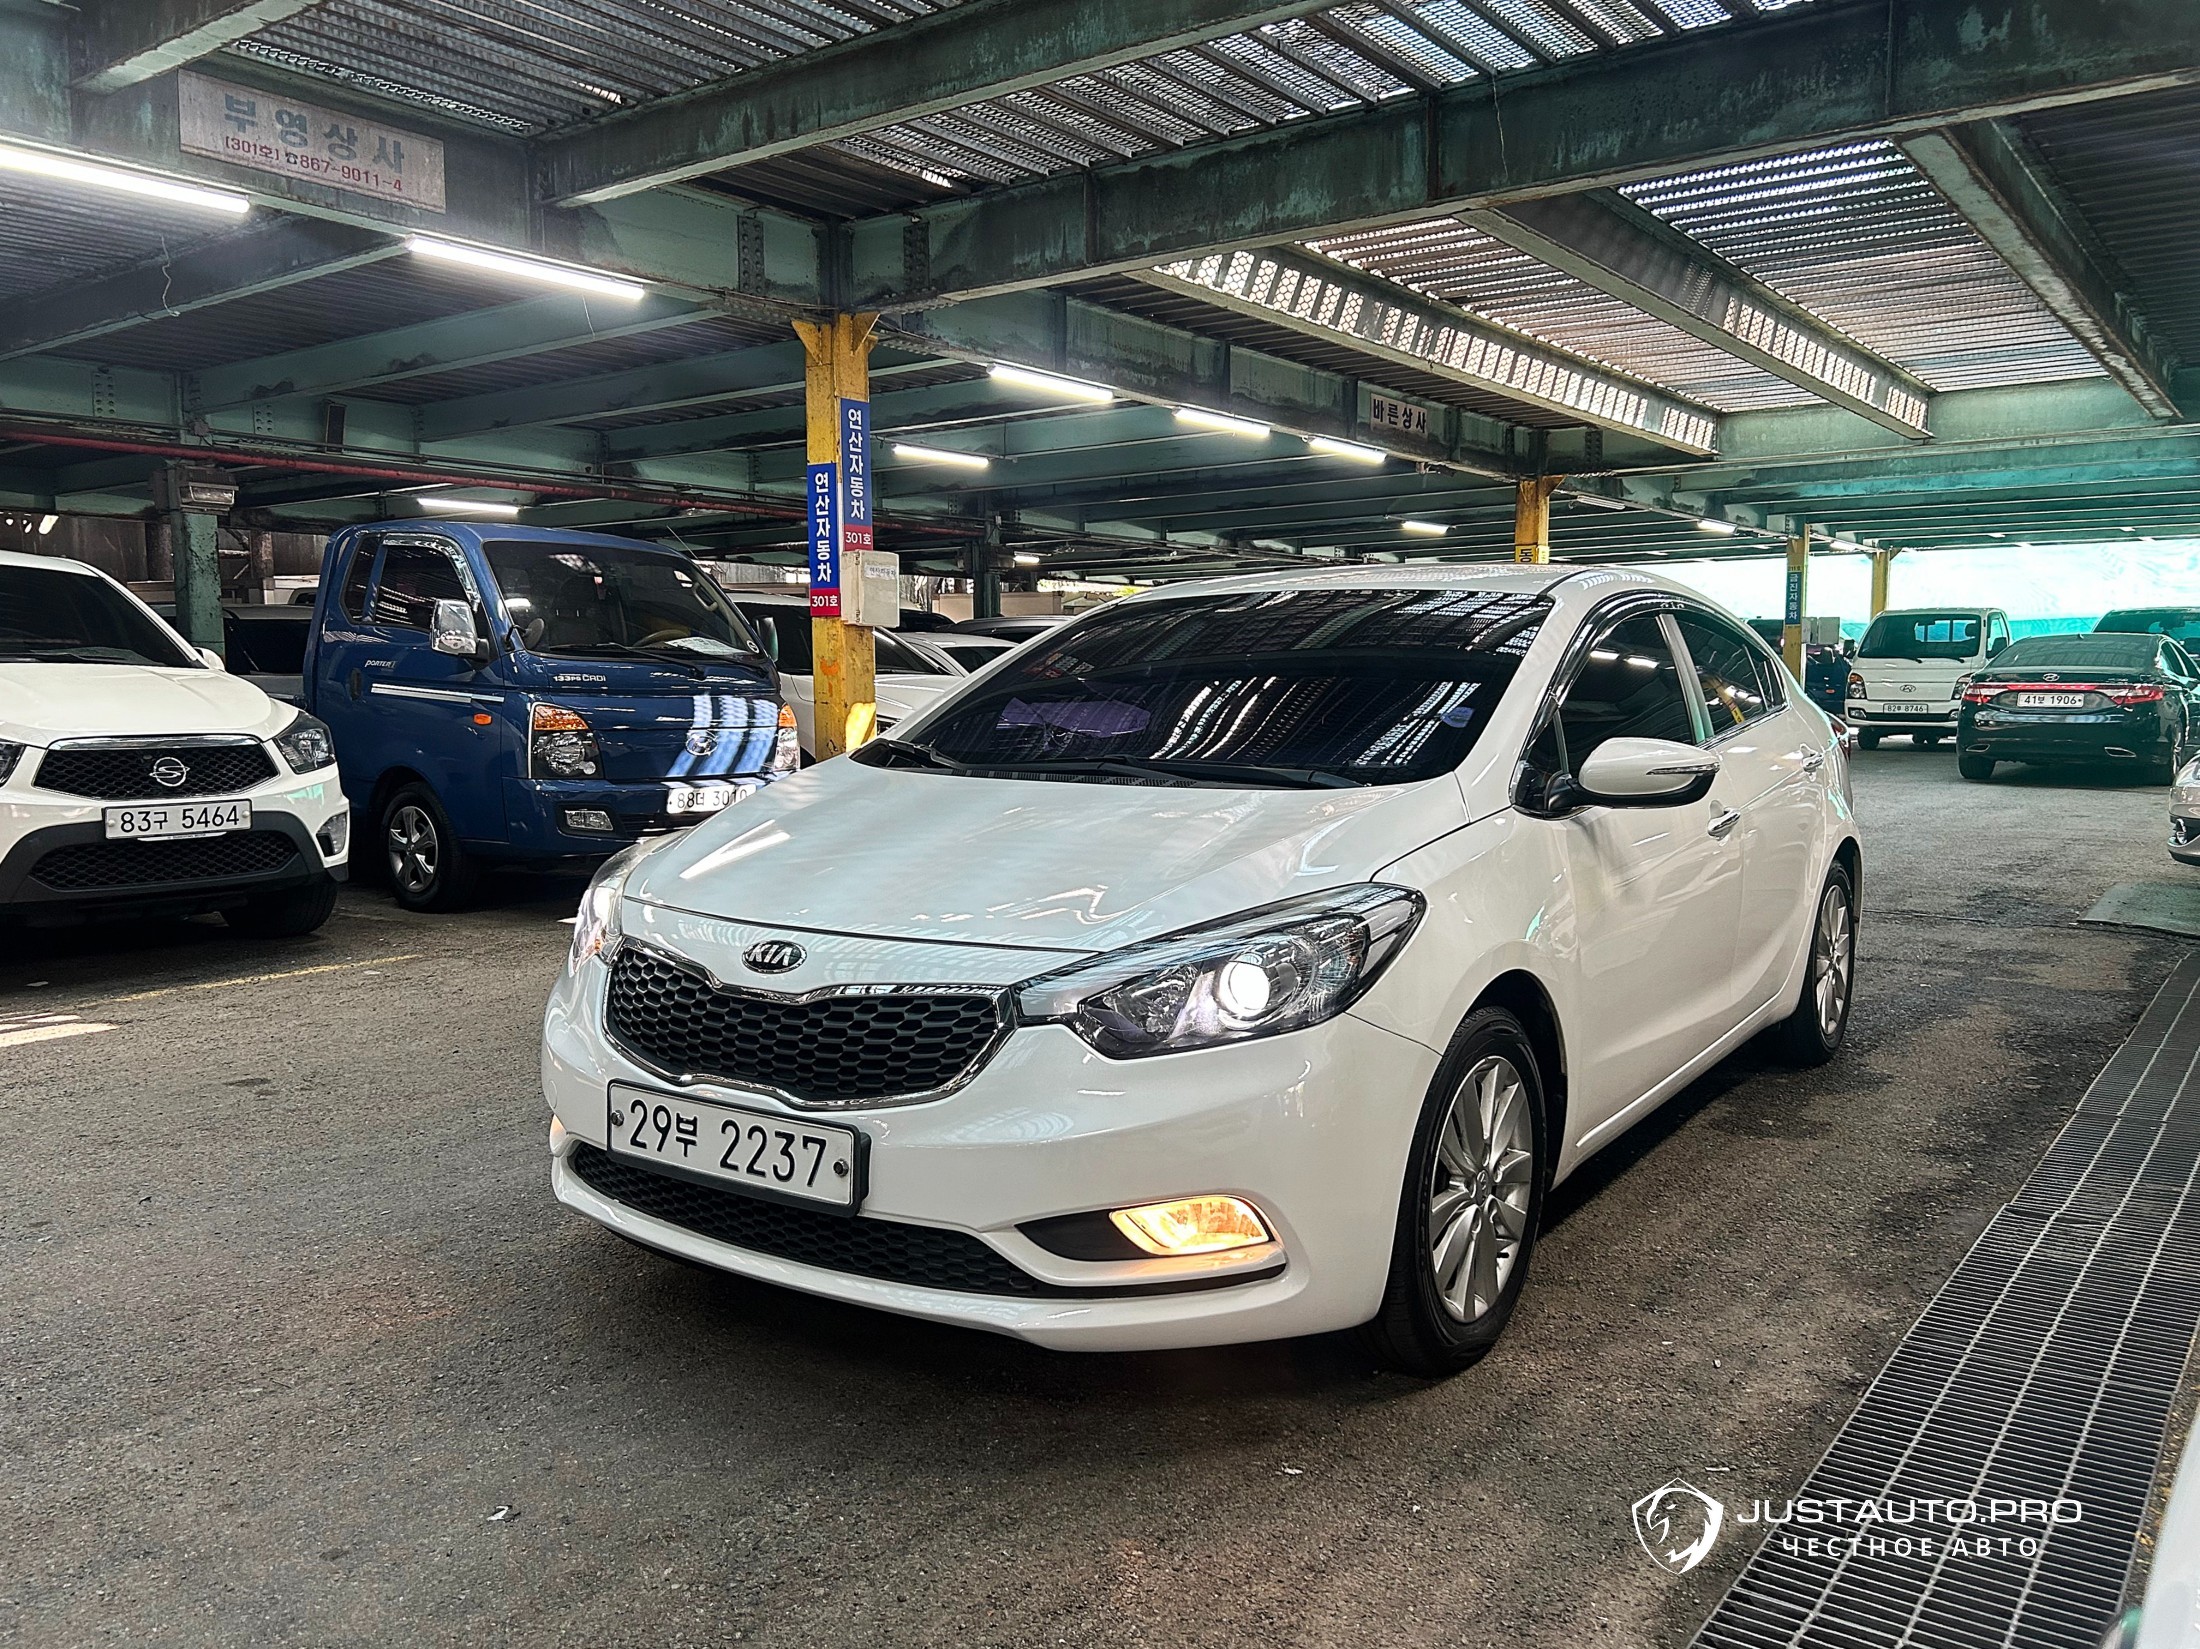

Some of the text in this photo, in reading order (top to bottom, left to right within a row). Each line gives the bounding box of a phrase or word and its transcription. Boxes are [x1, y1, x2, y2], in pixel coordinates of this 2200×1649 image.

[224, 93, 405, 174] 부영상사
[299, 153, 403, 192] 867-9011-4
[1373, 398, 1426, 434] 바른상사
[847, 408, 866, 521] 연산자동차
[814, 472, 832, 583] 연산자동차
[845, 531, 872, 545] 301호
[811, 595, 838, 608] 301호
[2050, 695, 2077, 705] 1906
[677, 792, 705, 809] 88더
[120, 805, 240, 833] 83구 5464
[748, 943, 793, 967] KIA
[629, 1099, 827, 1187] 29부 2237
